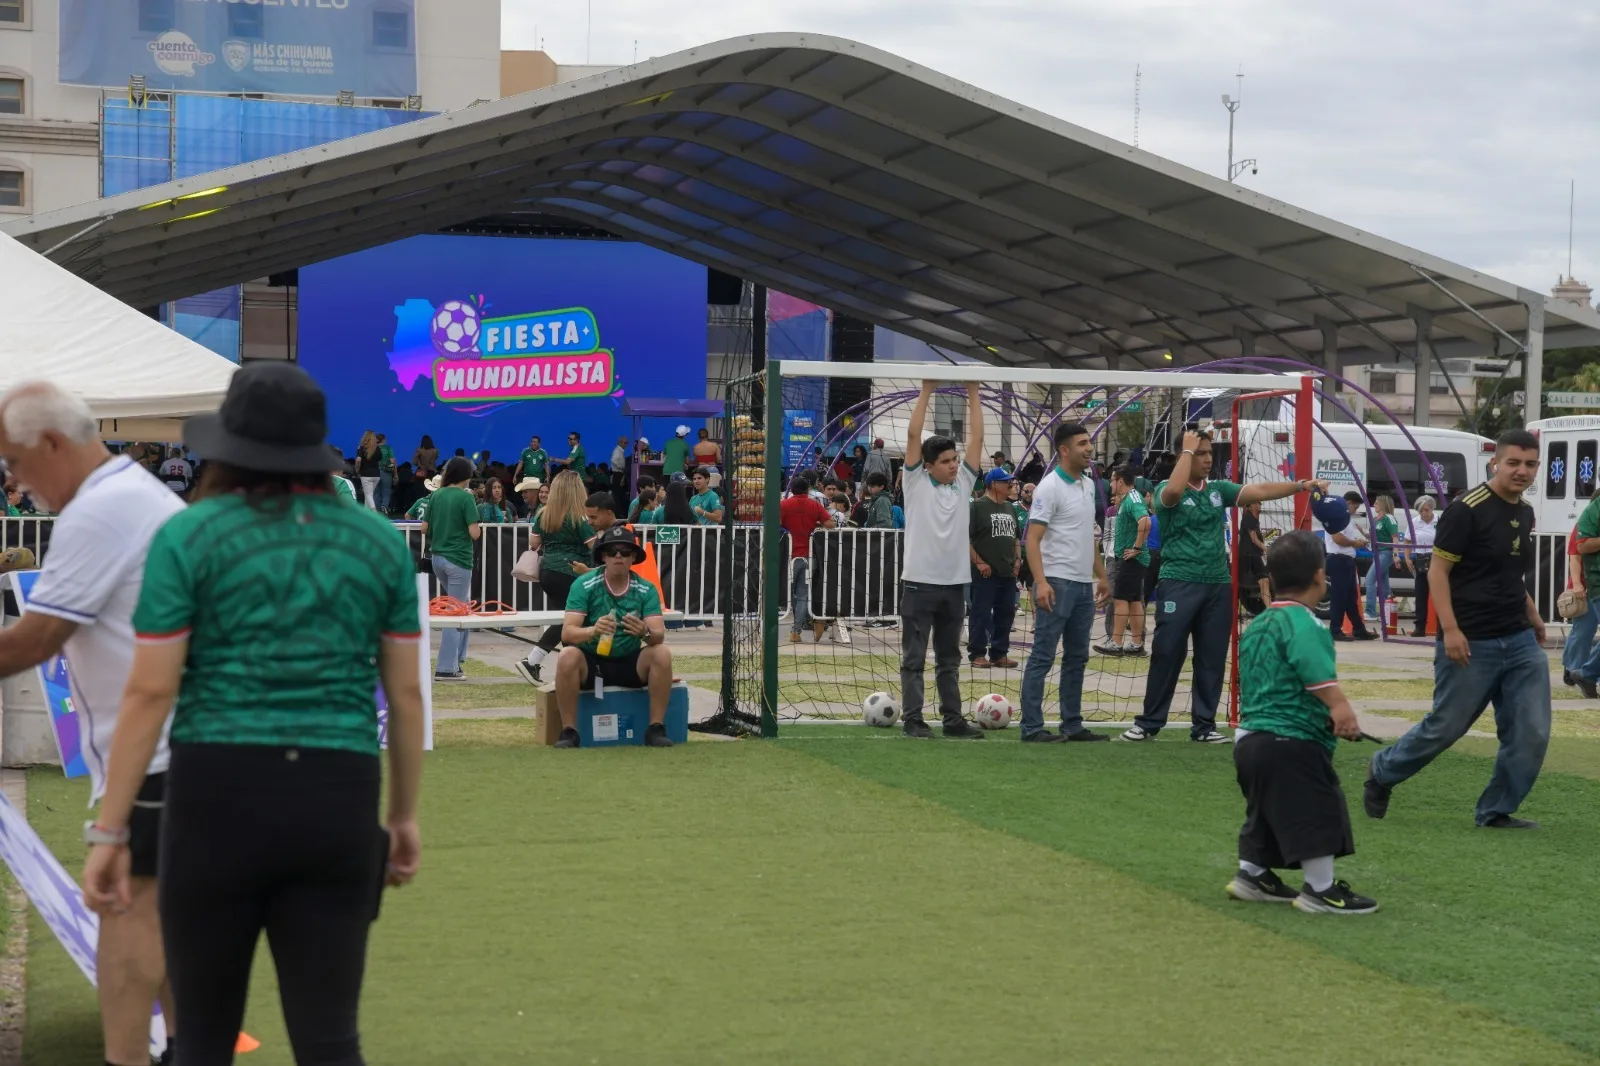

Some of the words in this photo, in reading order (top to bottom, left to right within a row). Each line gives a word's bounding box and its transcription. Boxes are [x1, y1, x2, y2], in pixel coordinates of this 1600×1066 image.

[148, 41, 198, 53] cuenta
[253, 42, 275, 58] MÁS
[277, 44, 333, 60] CHIHUAHUA
[157, 52, 214, 65] conmigo
[303, 60, 334, 68] bueno
[487, 320, 579, 352] FIESTA
[443, 361, 605, 391] MUNDIALISTA
[1550, 395, 1576, 404] CALLE
[1164, 601, 1177, 613] B
